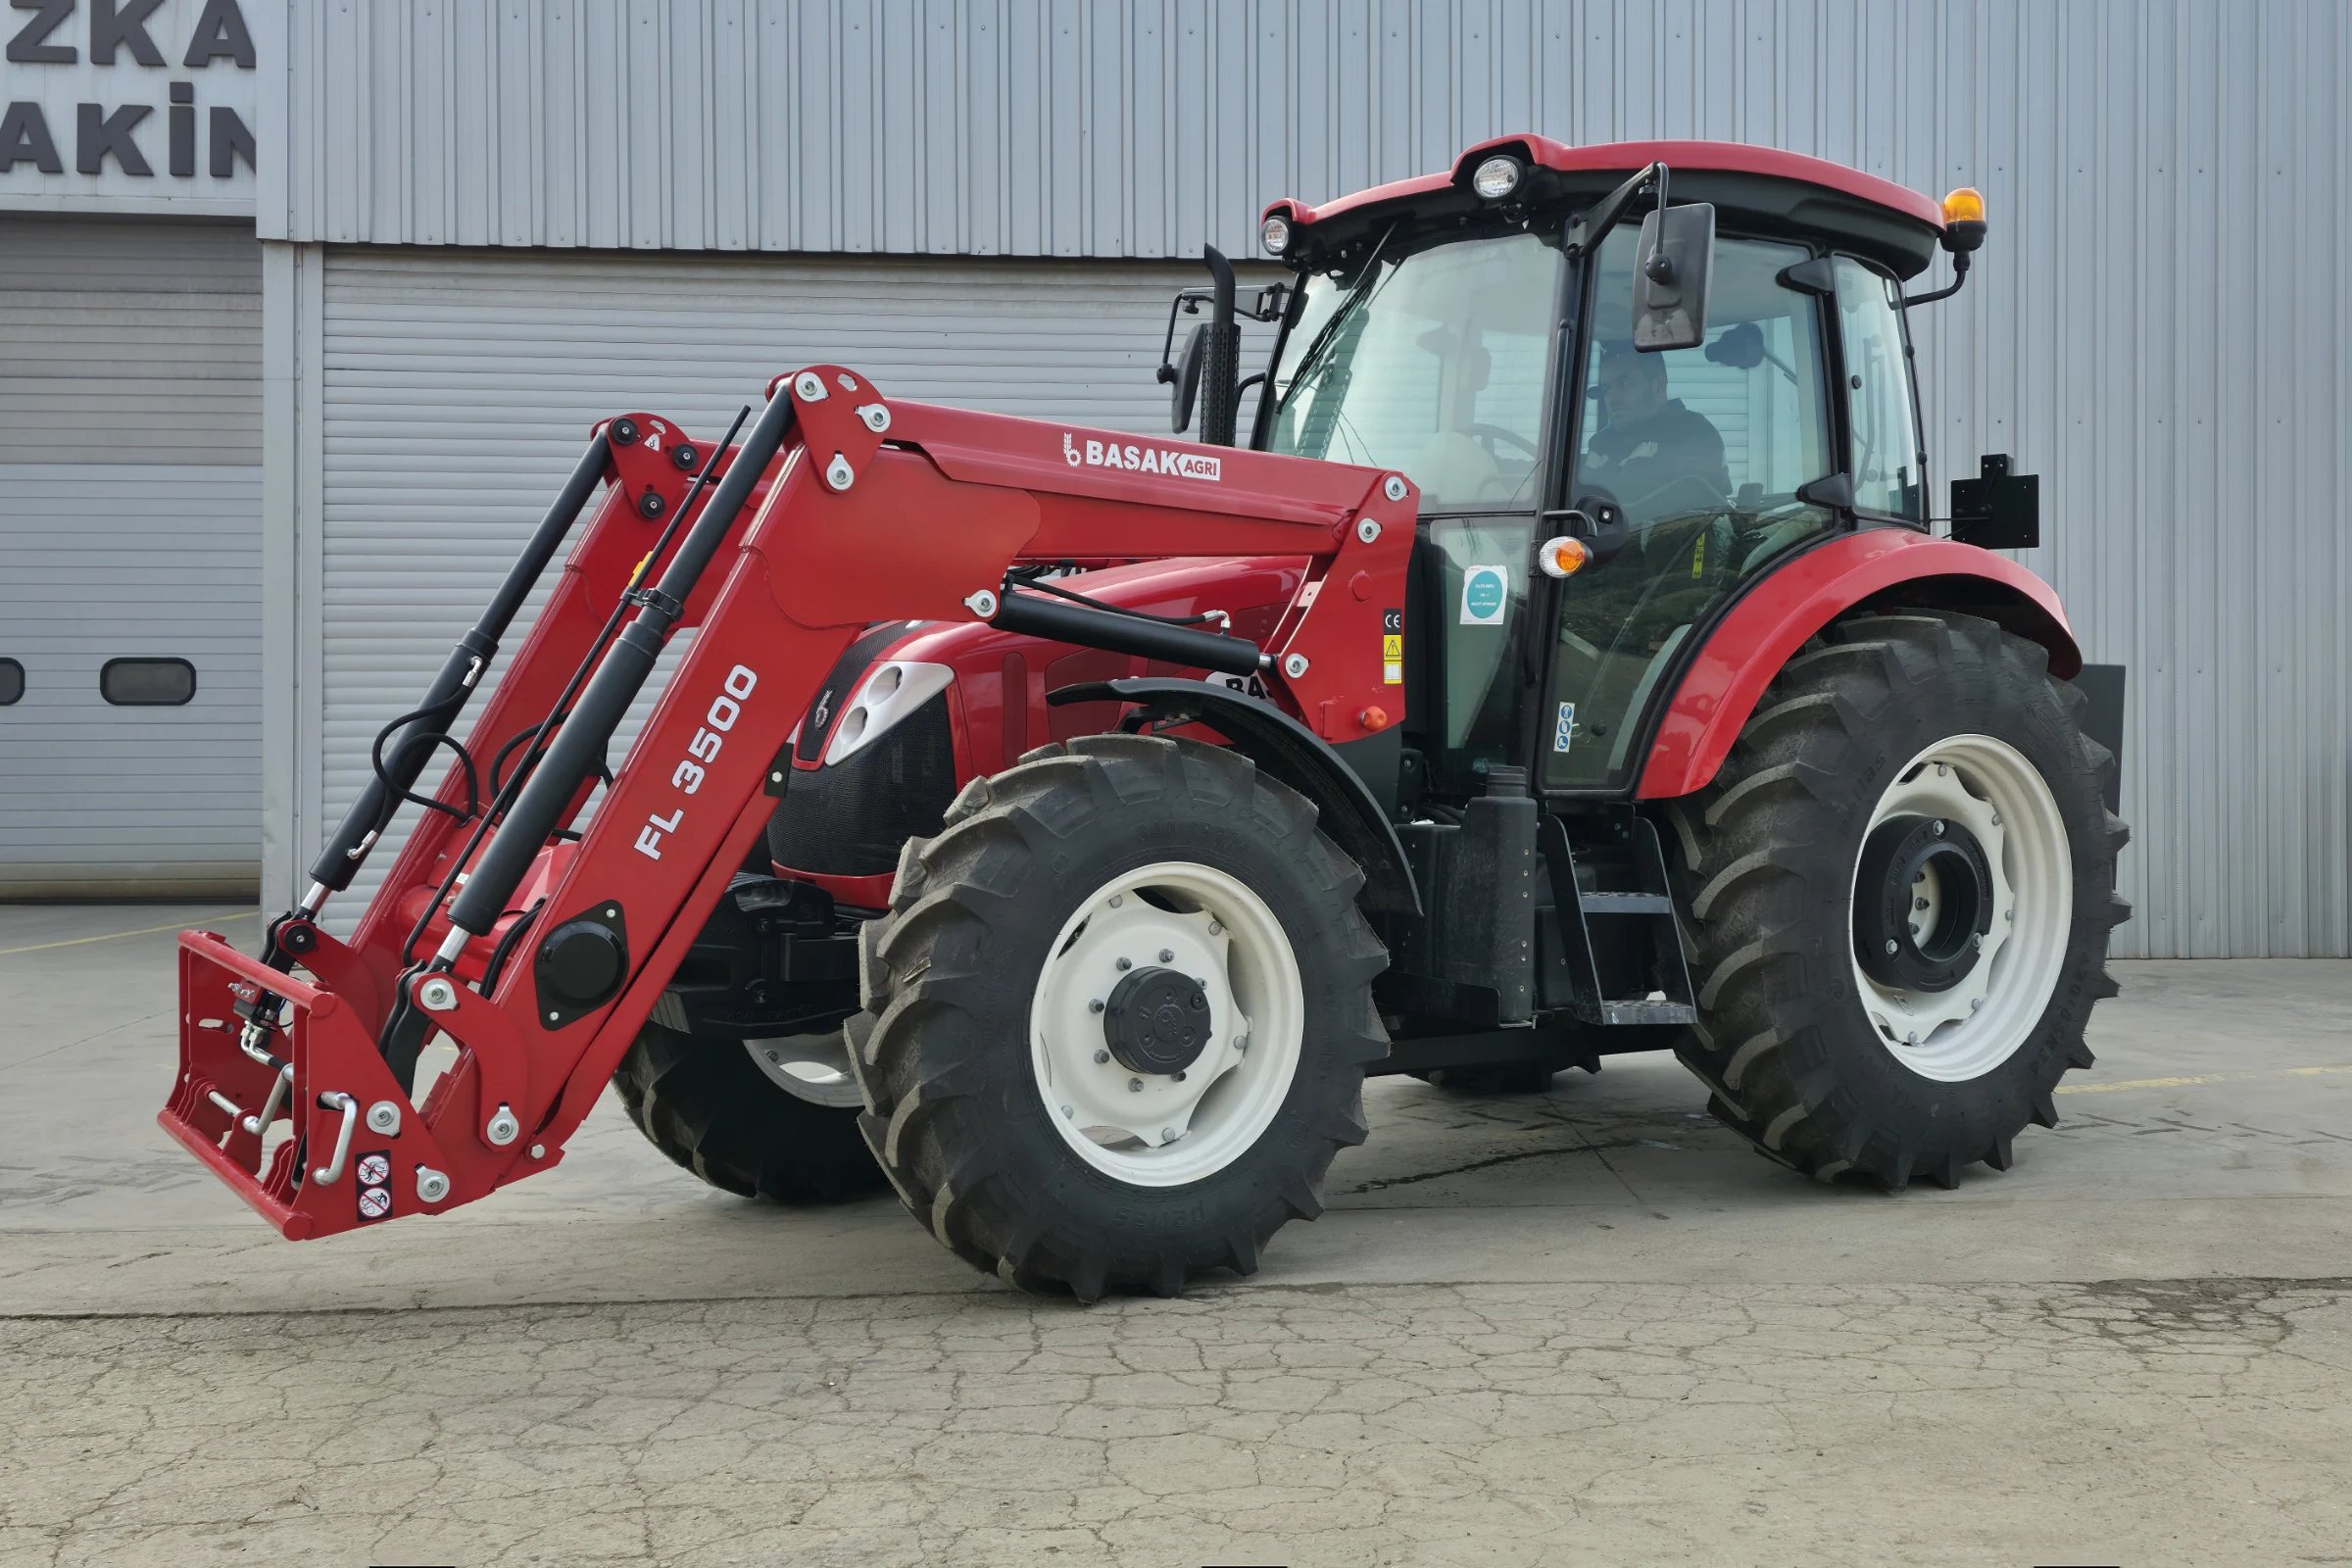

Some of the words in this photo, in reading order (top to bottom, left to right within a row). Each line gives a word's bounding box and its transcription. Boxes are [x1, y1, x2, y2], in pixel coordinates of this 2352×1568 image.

[6, 0, 256, 68] ZKA
[1184, 459, 1217, 476] AGRI
[1385, 613, 1400, 628] CE
[633, 808, 685, 860] FL
[671, 664, 758, 795] 3500
